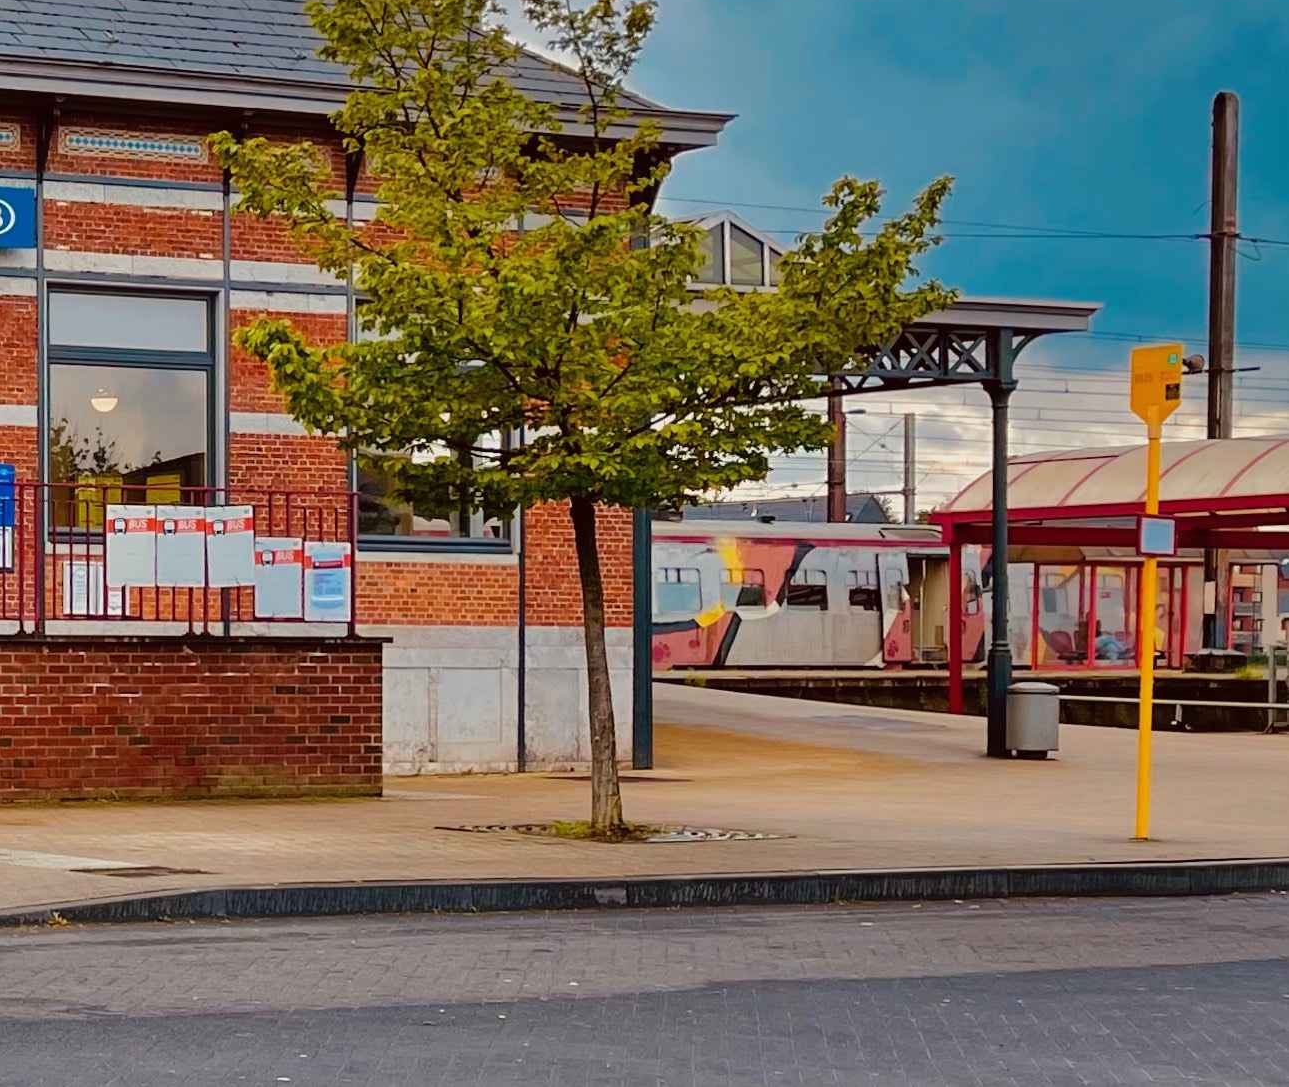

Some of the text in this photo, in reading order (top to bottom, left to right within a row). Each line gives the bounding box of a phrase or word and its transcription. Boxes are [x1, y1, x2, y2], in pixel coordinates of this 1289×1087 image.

[128, 519, 148, 530] BUS
[177, 519, 197, 530] BUS
[227, 519, 245, 530] BUS
[276, 550, 294, 563] BUS
